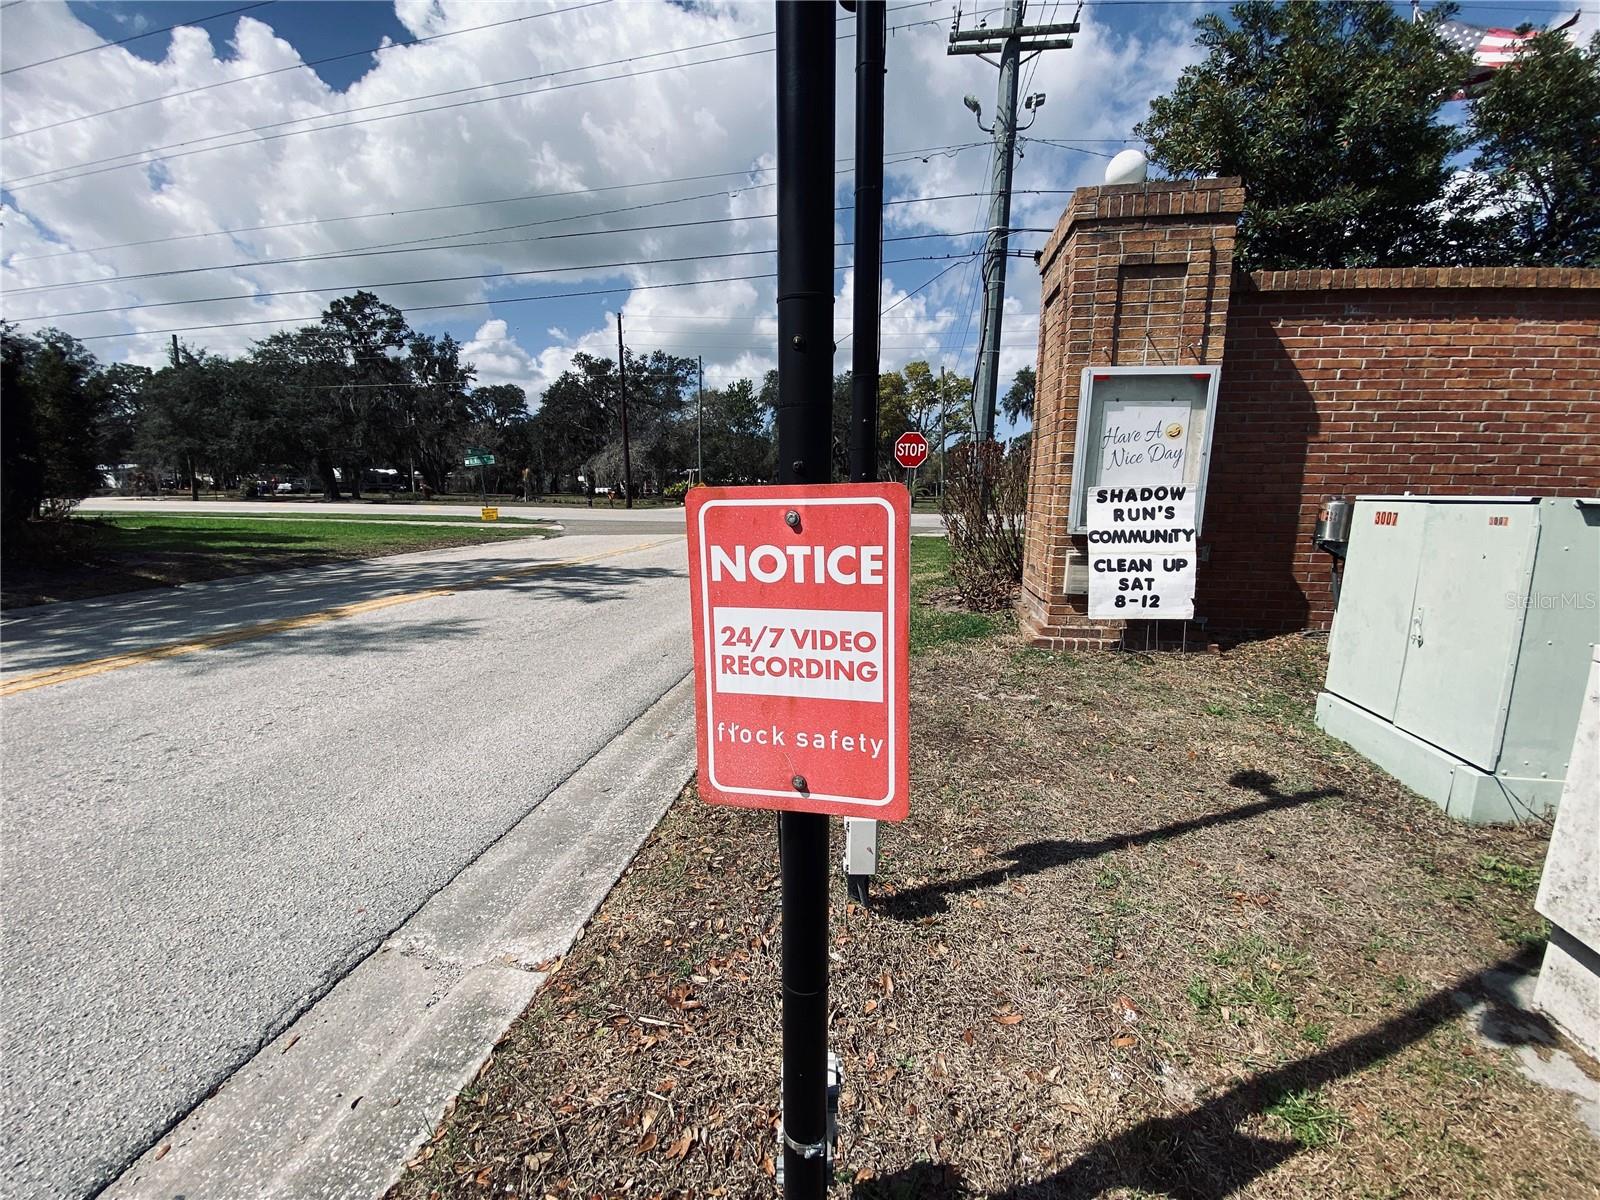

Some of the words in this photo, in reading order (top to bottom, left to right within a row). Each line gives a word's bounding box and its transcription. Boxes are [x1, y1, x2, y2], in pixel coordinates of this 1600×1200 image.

[1102, 426, 1142, 450] Have
[1144, 420, 1163, 442] A
[897, 443, 926, 457] STOP
[1106, 448, 1144, 470] Nice
[1147, 443, 1184, 469] Day
[1096, 486, 1187, 504] SHADOW
[1113, 505, 1176, 522] RUN'S
[1374, 511, 1399, 526] 3007
[1088, 528, 1195, 544] COMMUNITY
[711, 545, 884, 585] NOTICE
[1093, 558, 1152, 573] CLEAN
[1162, 558, 1188, 572] UP
[1118, 577, 1155, 591] SAT
[1114, 594, 1161, 608] 8-12
[720, 625, 786, 652] 24/7
[790, 629, 877, 653] VIDEO
[721, 655, 879, 683] RECORDING
[717, 722, 786, 746] flock
[796, 731, 885, 759] safety
